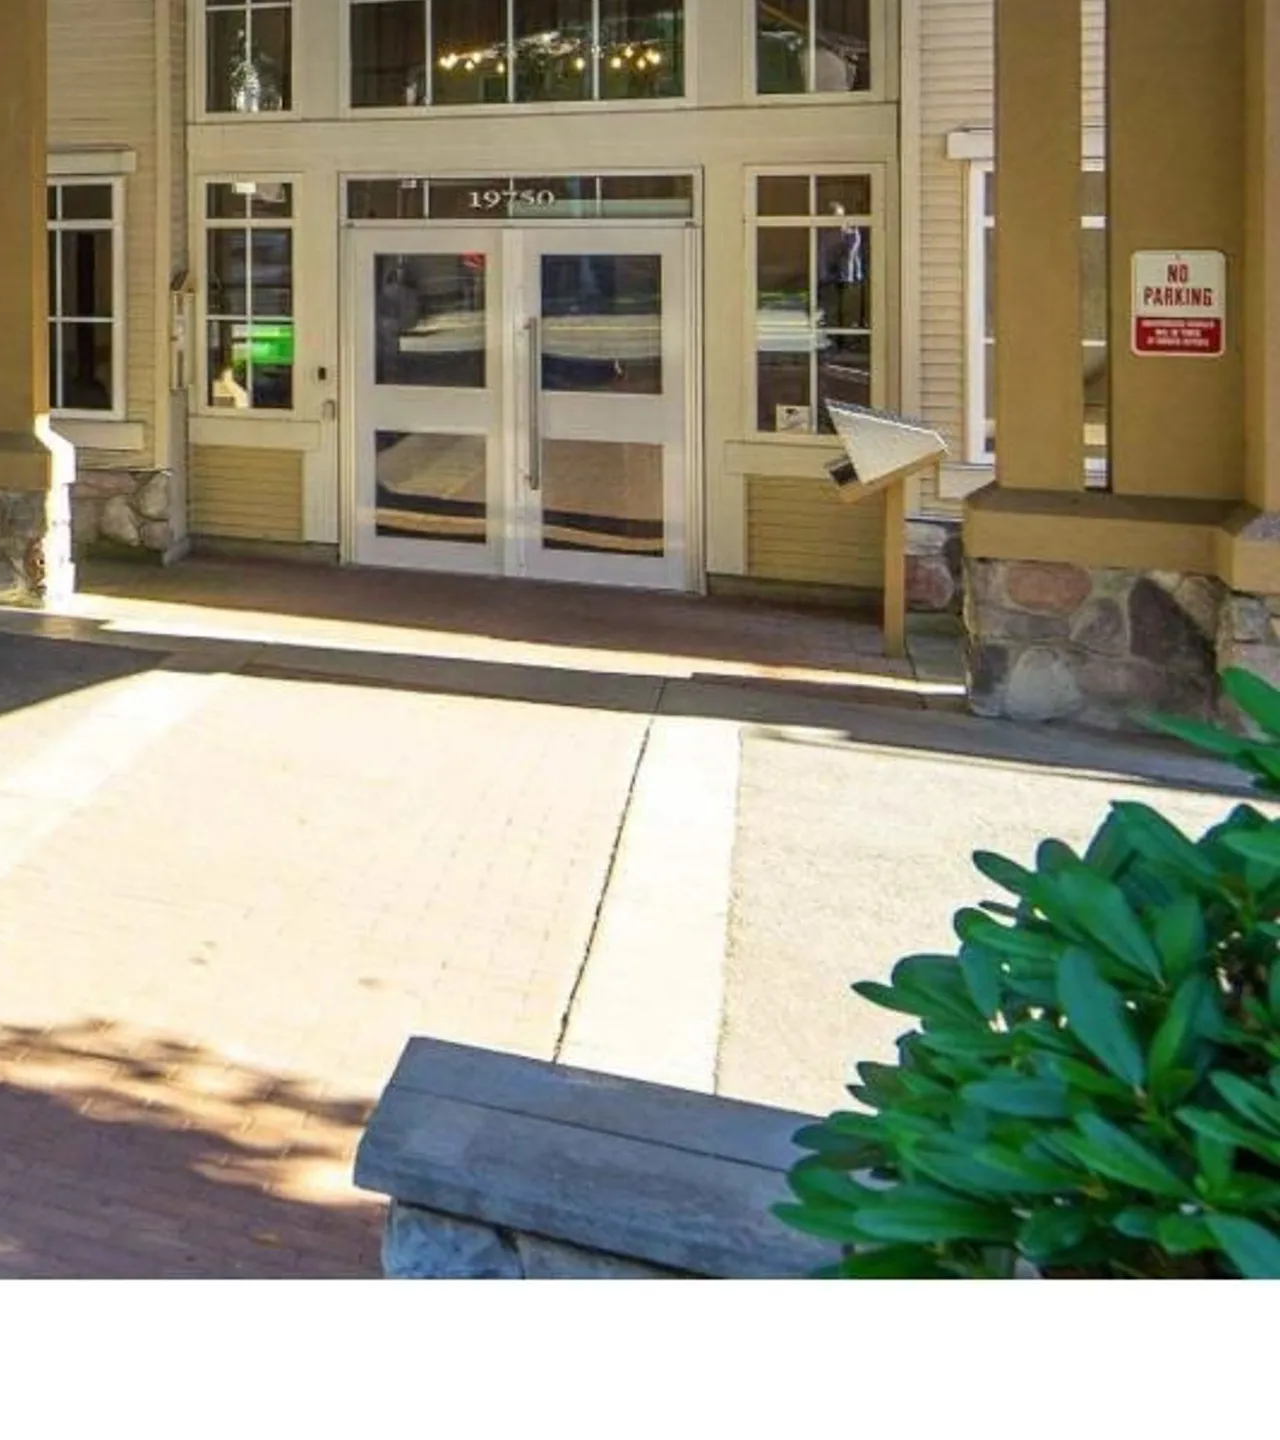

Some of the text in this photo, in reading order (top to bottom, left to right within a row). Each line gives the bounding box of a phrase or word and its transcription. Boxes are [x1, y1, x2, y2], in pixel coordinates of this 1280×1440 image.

[468, 189, 555, 209] 19750
[1167, 263, 1189, 283] NO
[1143, 286, 1213, 306] PARKING
